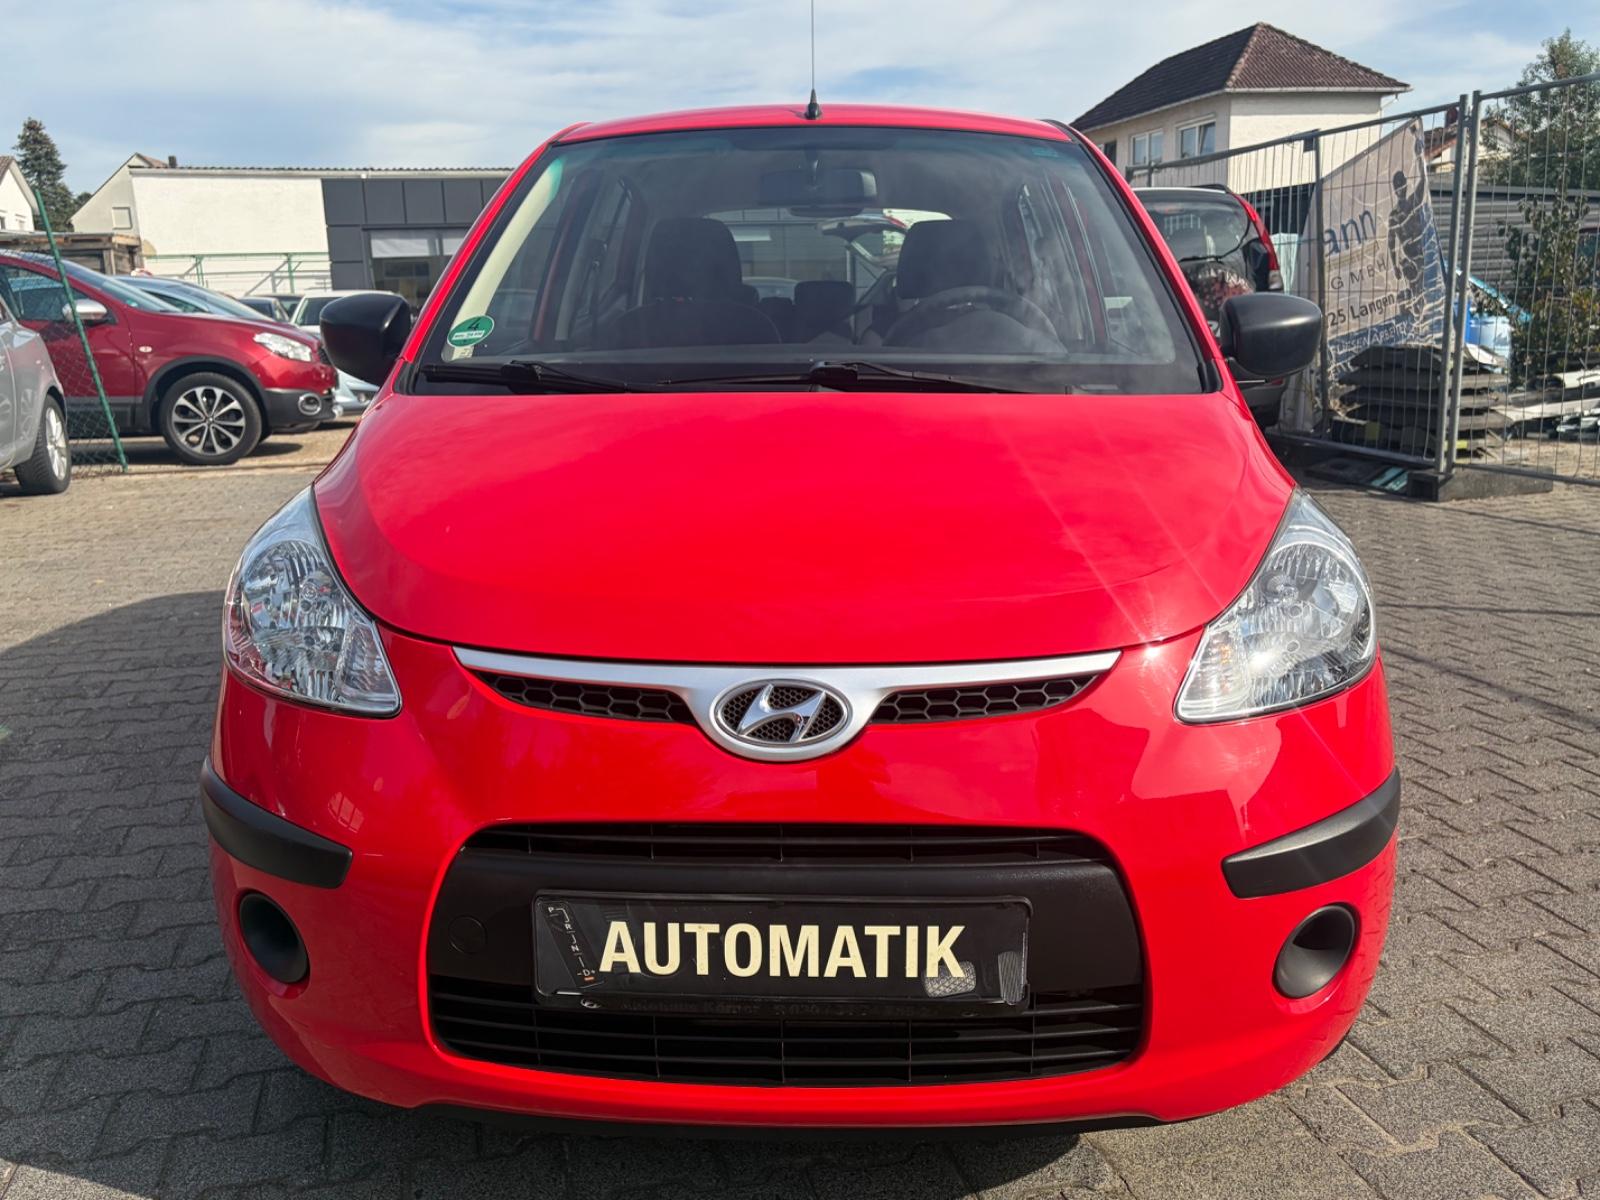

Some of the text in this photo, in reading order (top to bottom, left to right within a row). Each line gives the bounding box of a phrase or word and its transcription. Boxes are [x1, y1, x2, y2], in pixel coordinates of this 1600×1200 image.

[1350, 293, 1395, 319] Langen
[468, 317, 482, 330] 4
[599, 921, 966, 977] AUTOMATIK
